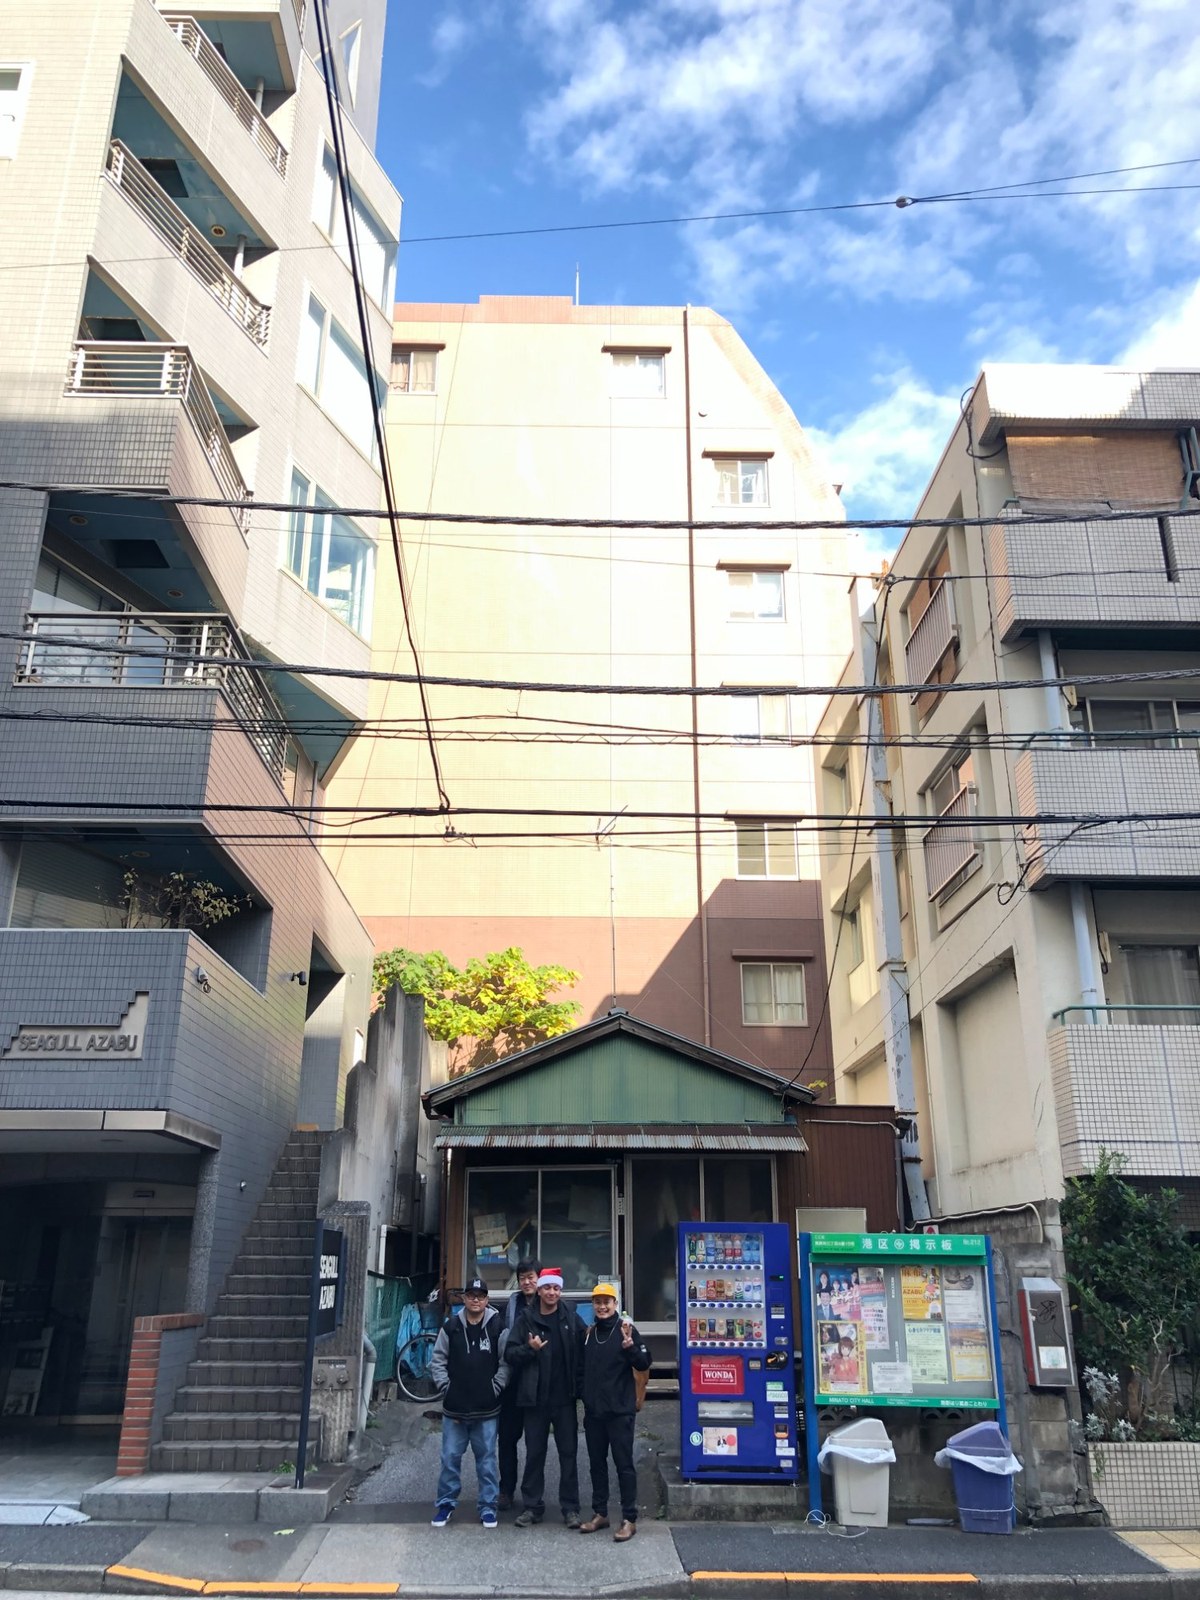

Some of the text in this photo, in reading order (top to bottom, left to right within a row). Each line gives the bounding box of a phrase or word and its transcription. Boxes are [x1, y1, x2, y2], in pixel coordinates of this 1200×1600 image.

[19, 1033, 138, 1051] SEAGULL AZABU
[862, 1238, 888, 1249] 港区
[909, 1238, 952, 1251] 掲示板
[319, 1254, 338, 1279] SEAGULL
[704, 1371, 733, 1379] WONDA
